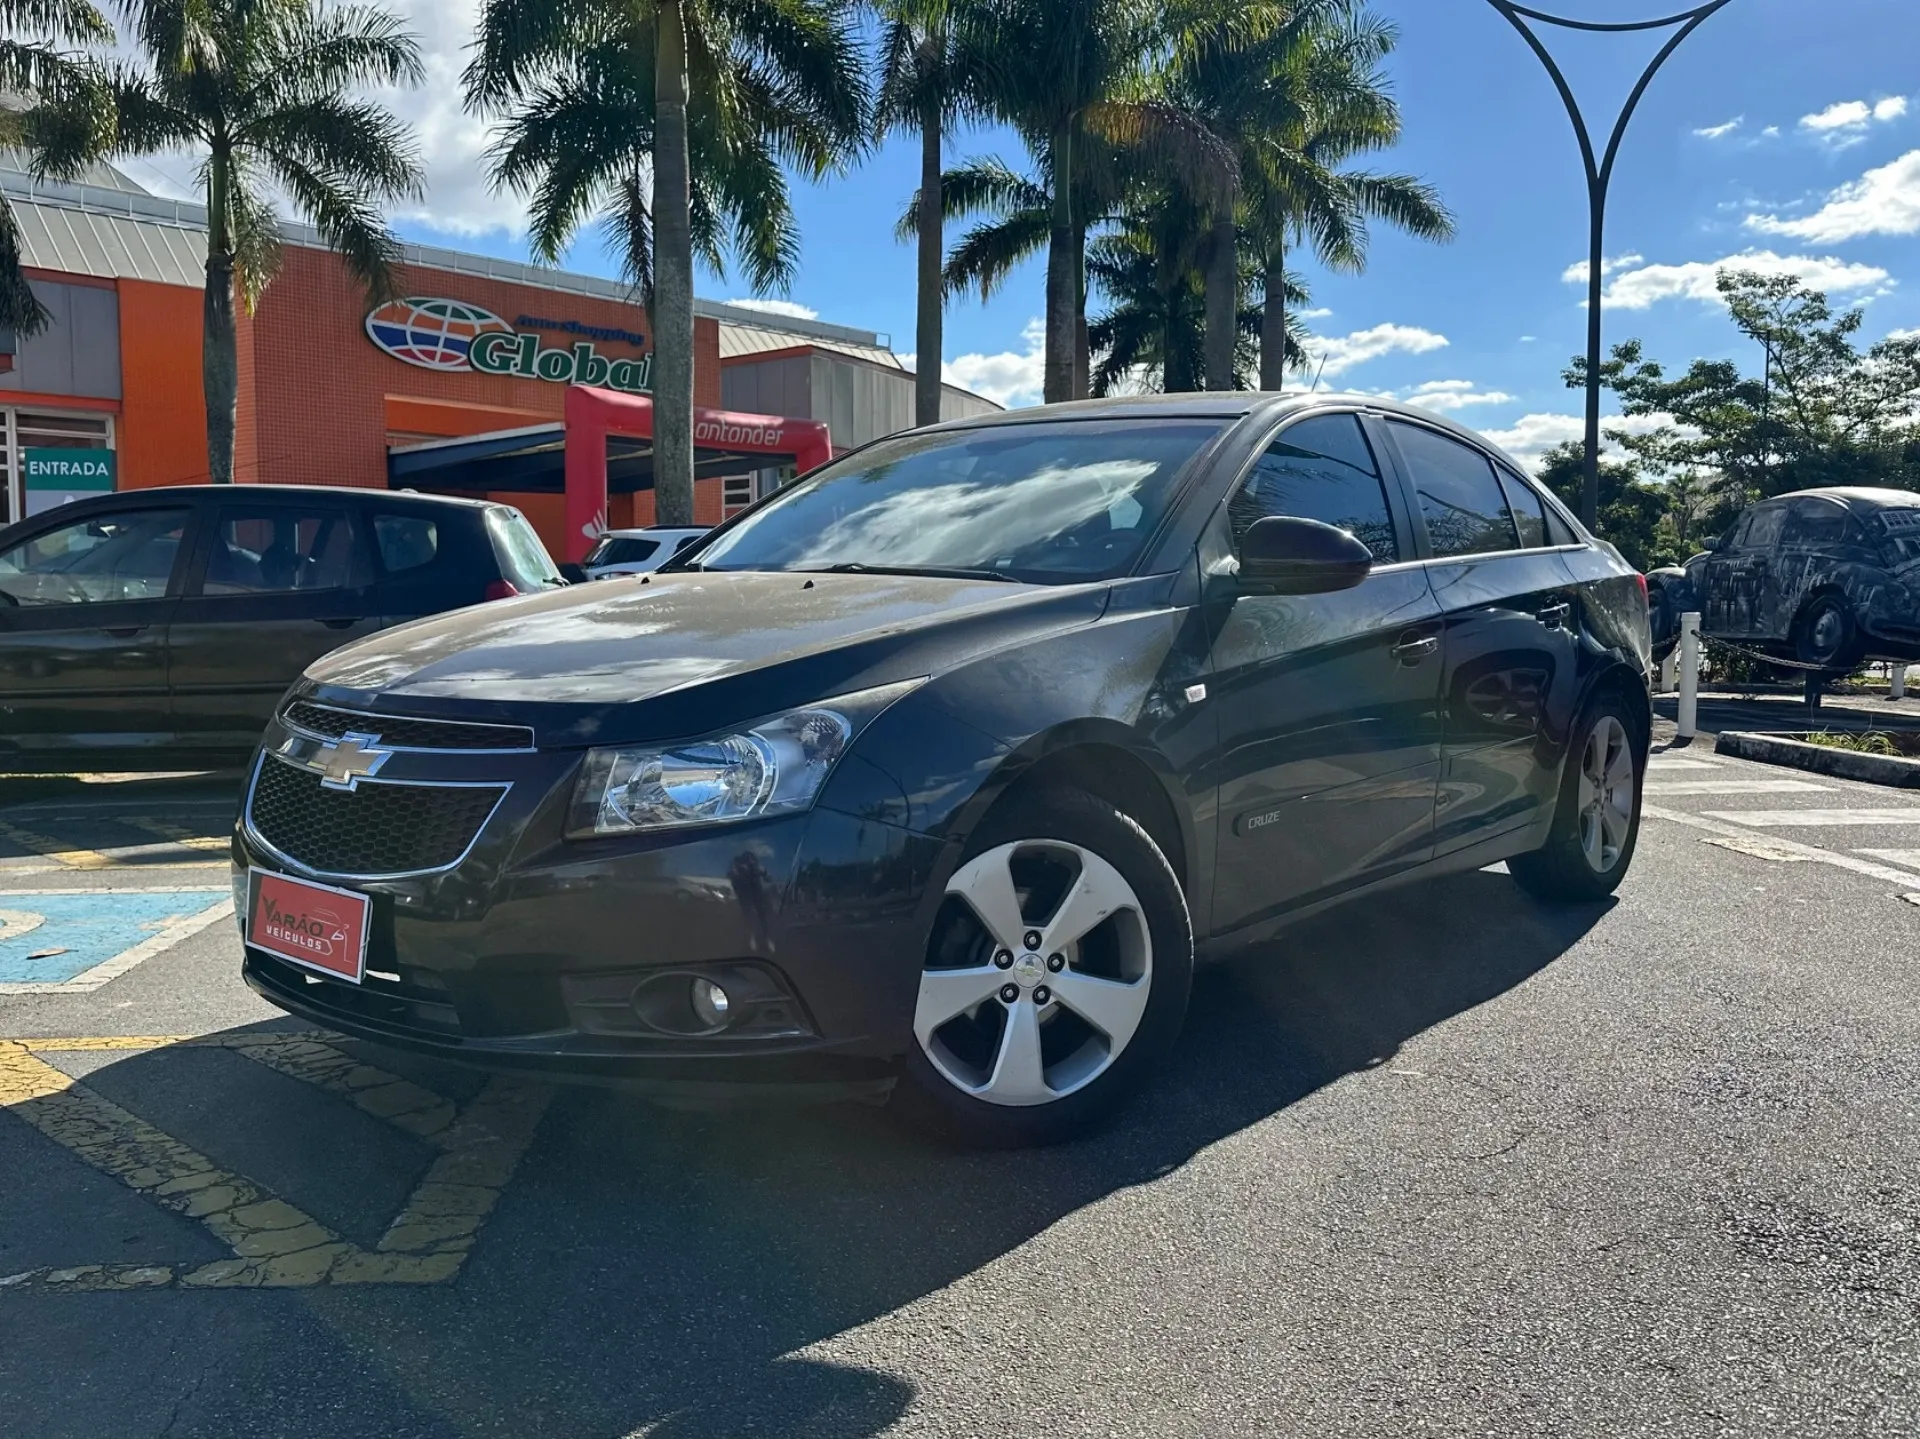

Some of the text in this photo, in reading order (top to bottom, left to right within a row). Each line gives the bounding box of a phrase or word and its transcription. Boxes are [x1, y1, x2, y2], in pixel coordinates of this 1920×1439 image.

[563, 320, 645, 346] Shopping
[695, 420, 784, 446] antander
[29, 461, 109, 476] ENTRADA
[1248, 811, 1280, 829] CRUZE
[262, 894, 323, 937] VARÃO
[266, 925, 322, 950] VEÍCULOS
